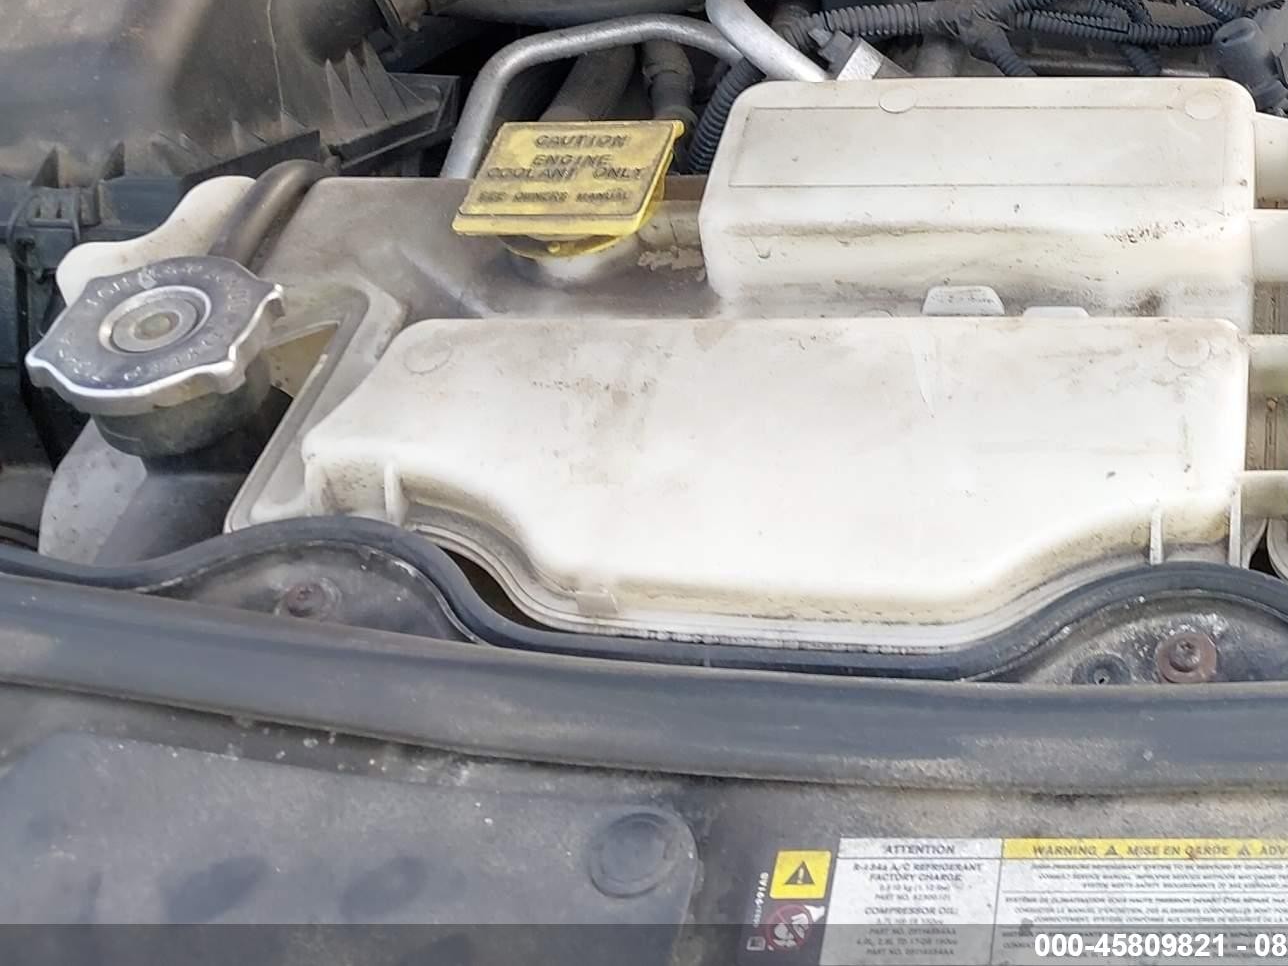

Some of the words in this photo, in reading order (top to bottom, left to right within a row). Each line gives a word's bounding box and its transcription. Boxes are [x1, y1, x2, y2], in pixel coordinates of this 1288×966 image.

[535, 134, 630, 148] CAUTION
[532, 154, 613, 167] ENGINE
[487, 167, 578, 180] COOLANT
[592, 167, 644, 179] ONLY
[884, 844, 956, 855] ATTENTION
[1032, 844, 1096, 856] WARNING
[1127, 844, 1160, 856] MISE
[1163, 844, 1181, 856] EN
[1184, 845, 1229, 856] GARDE
[913, 863, 983, 872] REFRIGERANT
[869, 873, 915, 882] FACTORY
[864, 906, 937, 915] COMPRESSOR
